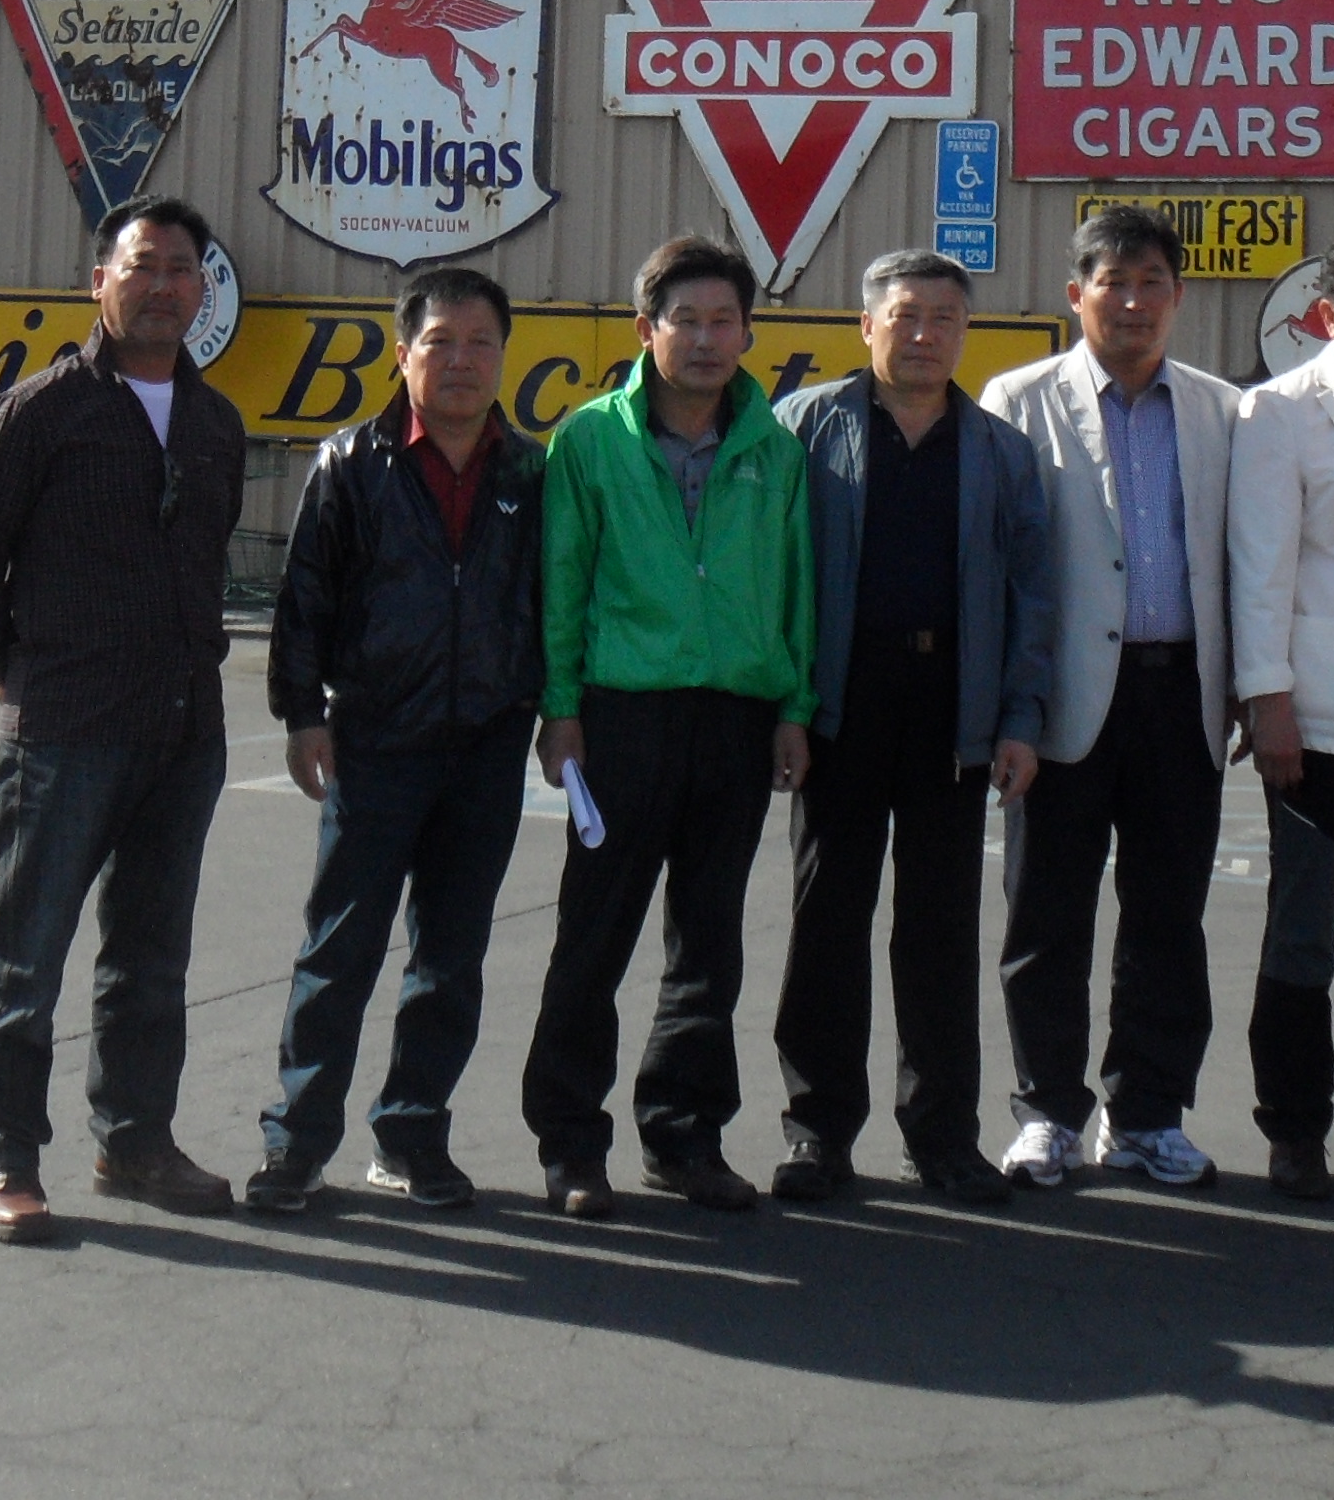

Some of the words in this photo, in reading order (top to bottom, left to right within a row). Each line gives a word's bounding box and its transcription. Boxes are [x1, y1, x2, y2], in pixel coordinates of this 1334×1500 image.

[53, 5, 201, 45] Seaside
[637, 36, 939, 91] CONOCO
[70, 80, 177, 103] GAOLIE
[945, 128, 992, 140] RESERVED
[1072, 106, 1323, 159] CIGARS
[947, 141, 989, 153] PARKING
[291, 115, 524, 213] Mobilgas
[939, 202, 992, 214] ACCESSIBLE
[339, 217, 470, 234] SOCONY-VACUUM
[944, 230, 987, 244] MINIMUM
[1180, 249, 1253, 273] OLINE
[199, 323, 230, 358] OIL
